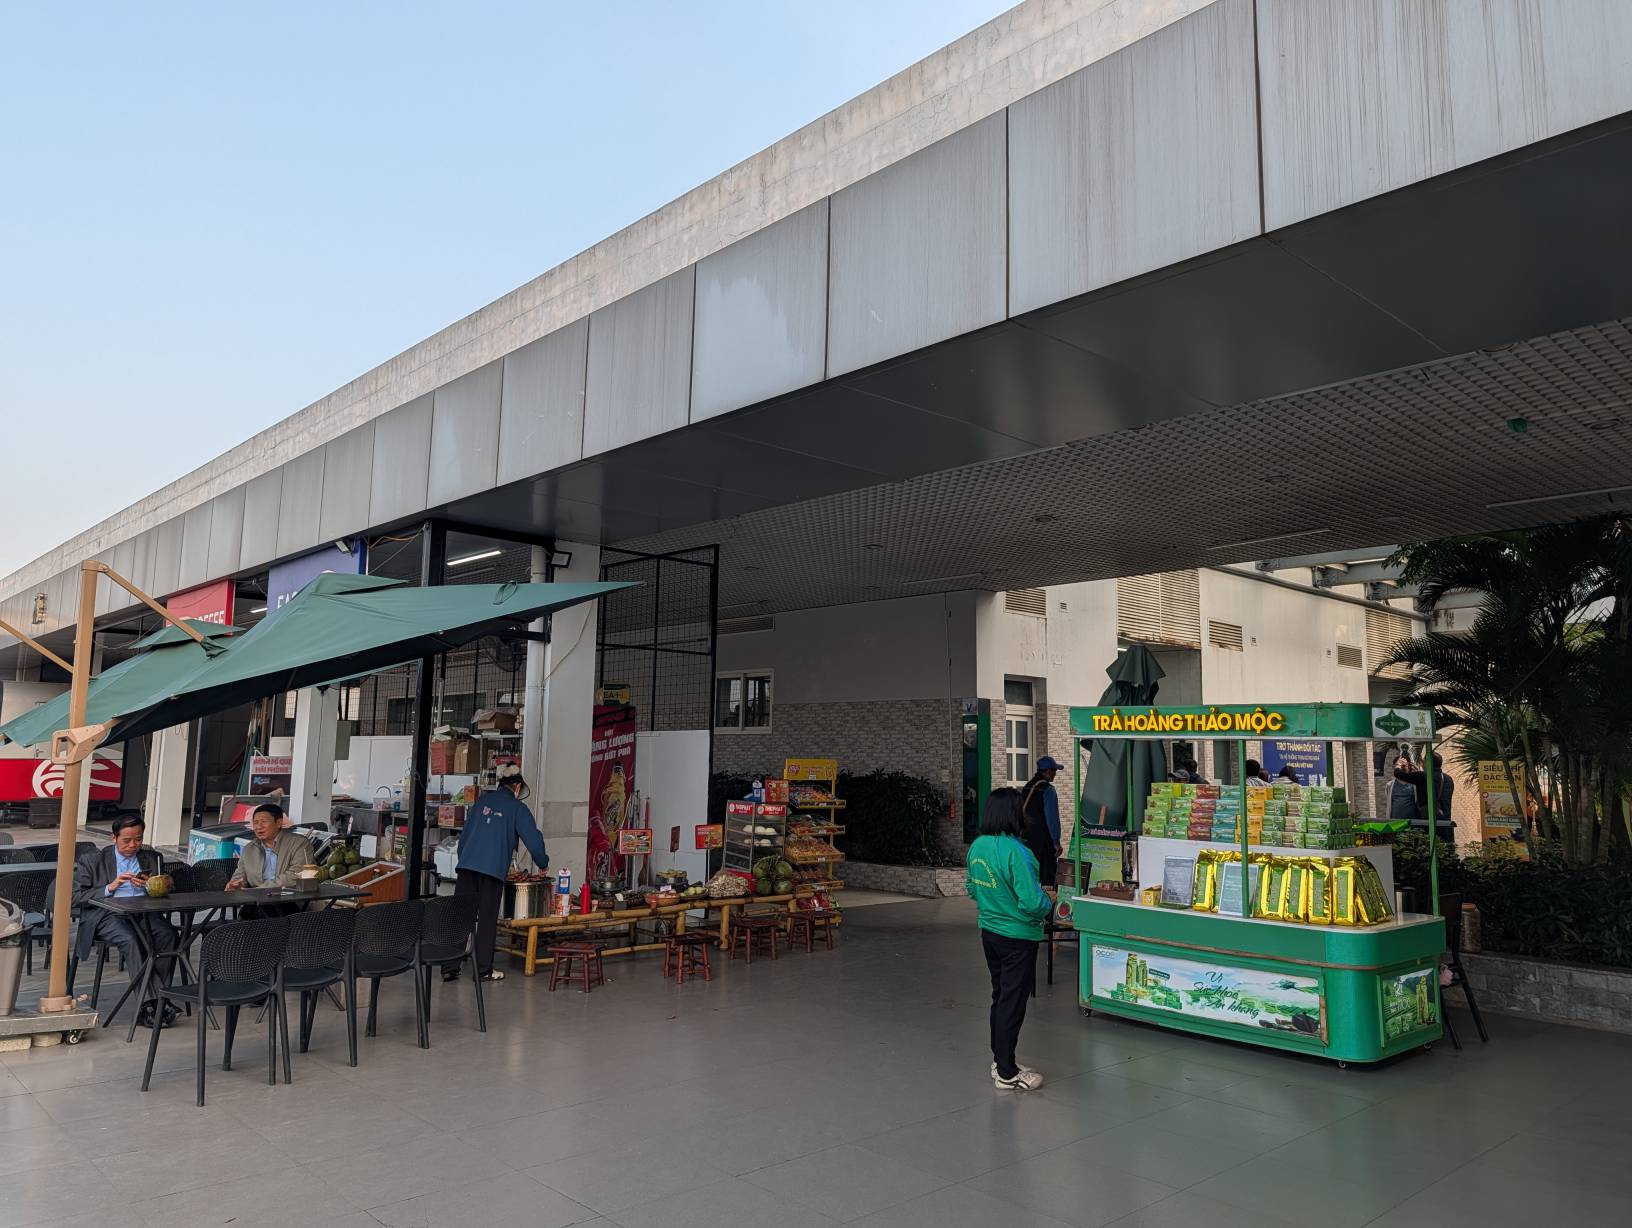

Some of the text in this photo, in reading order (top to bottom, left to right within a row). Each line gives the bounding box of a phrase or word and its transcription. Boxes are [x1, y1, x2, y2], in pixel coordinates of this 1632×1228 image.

[1093, 706, 1283, 735] TRÀ HOÀNG THẢO MỘC
